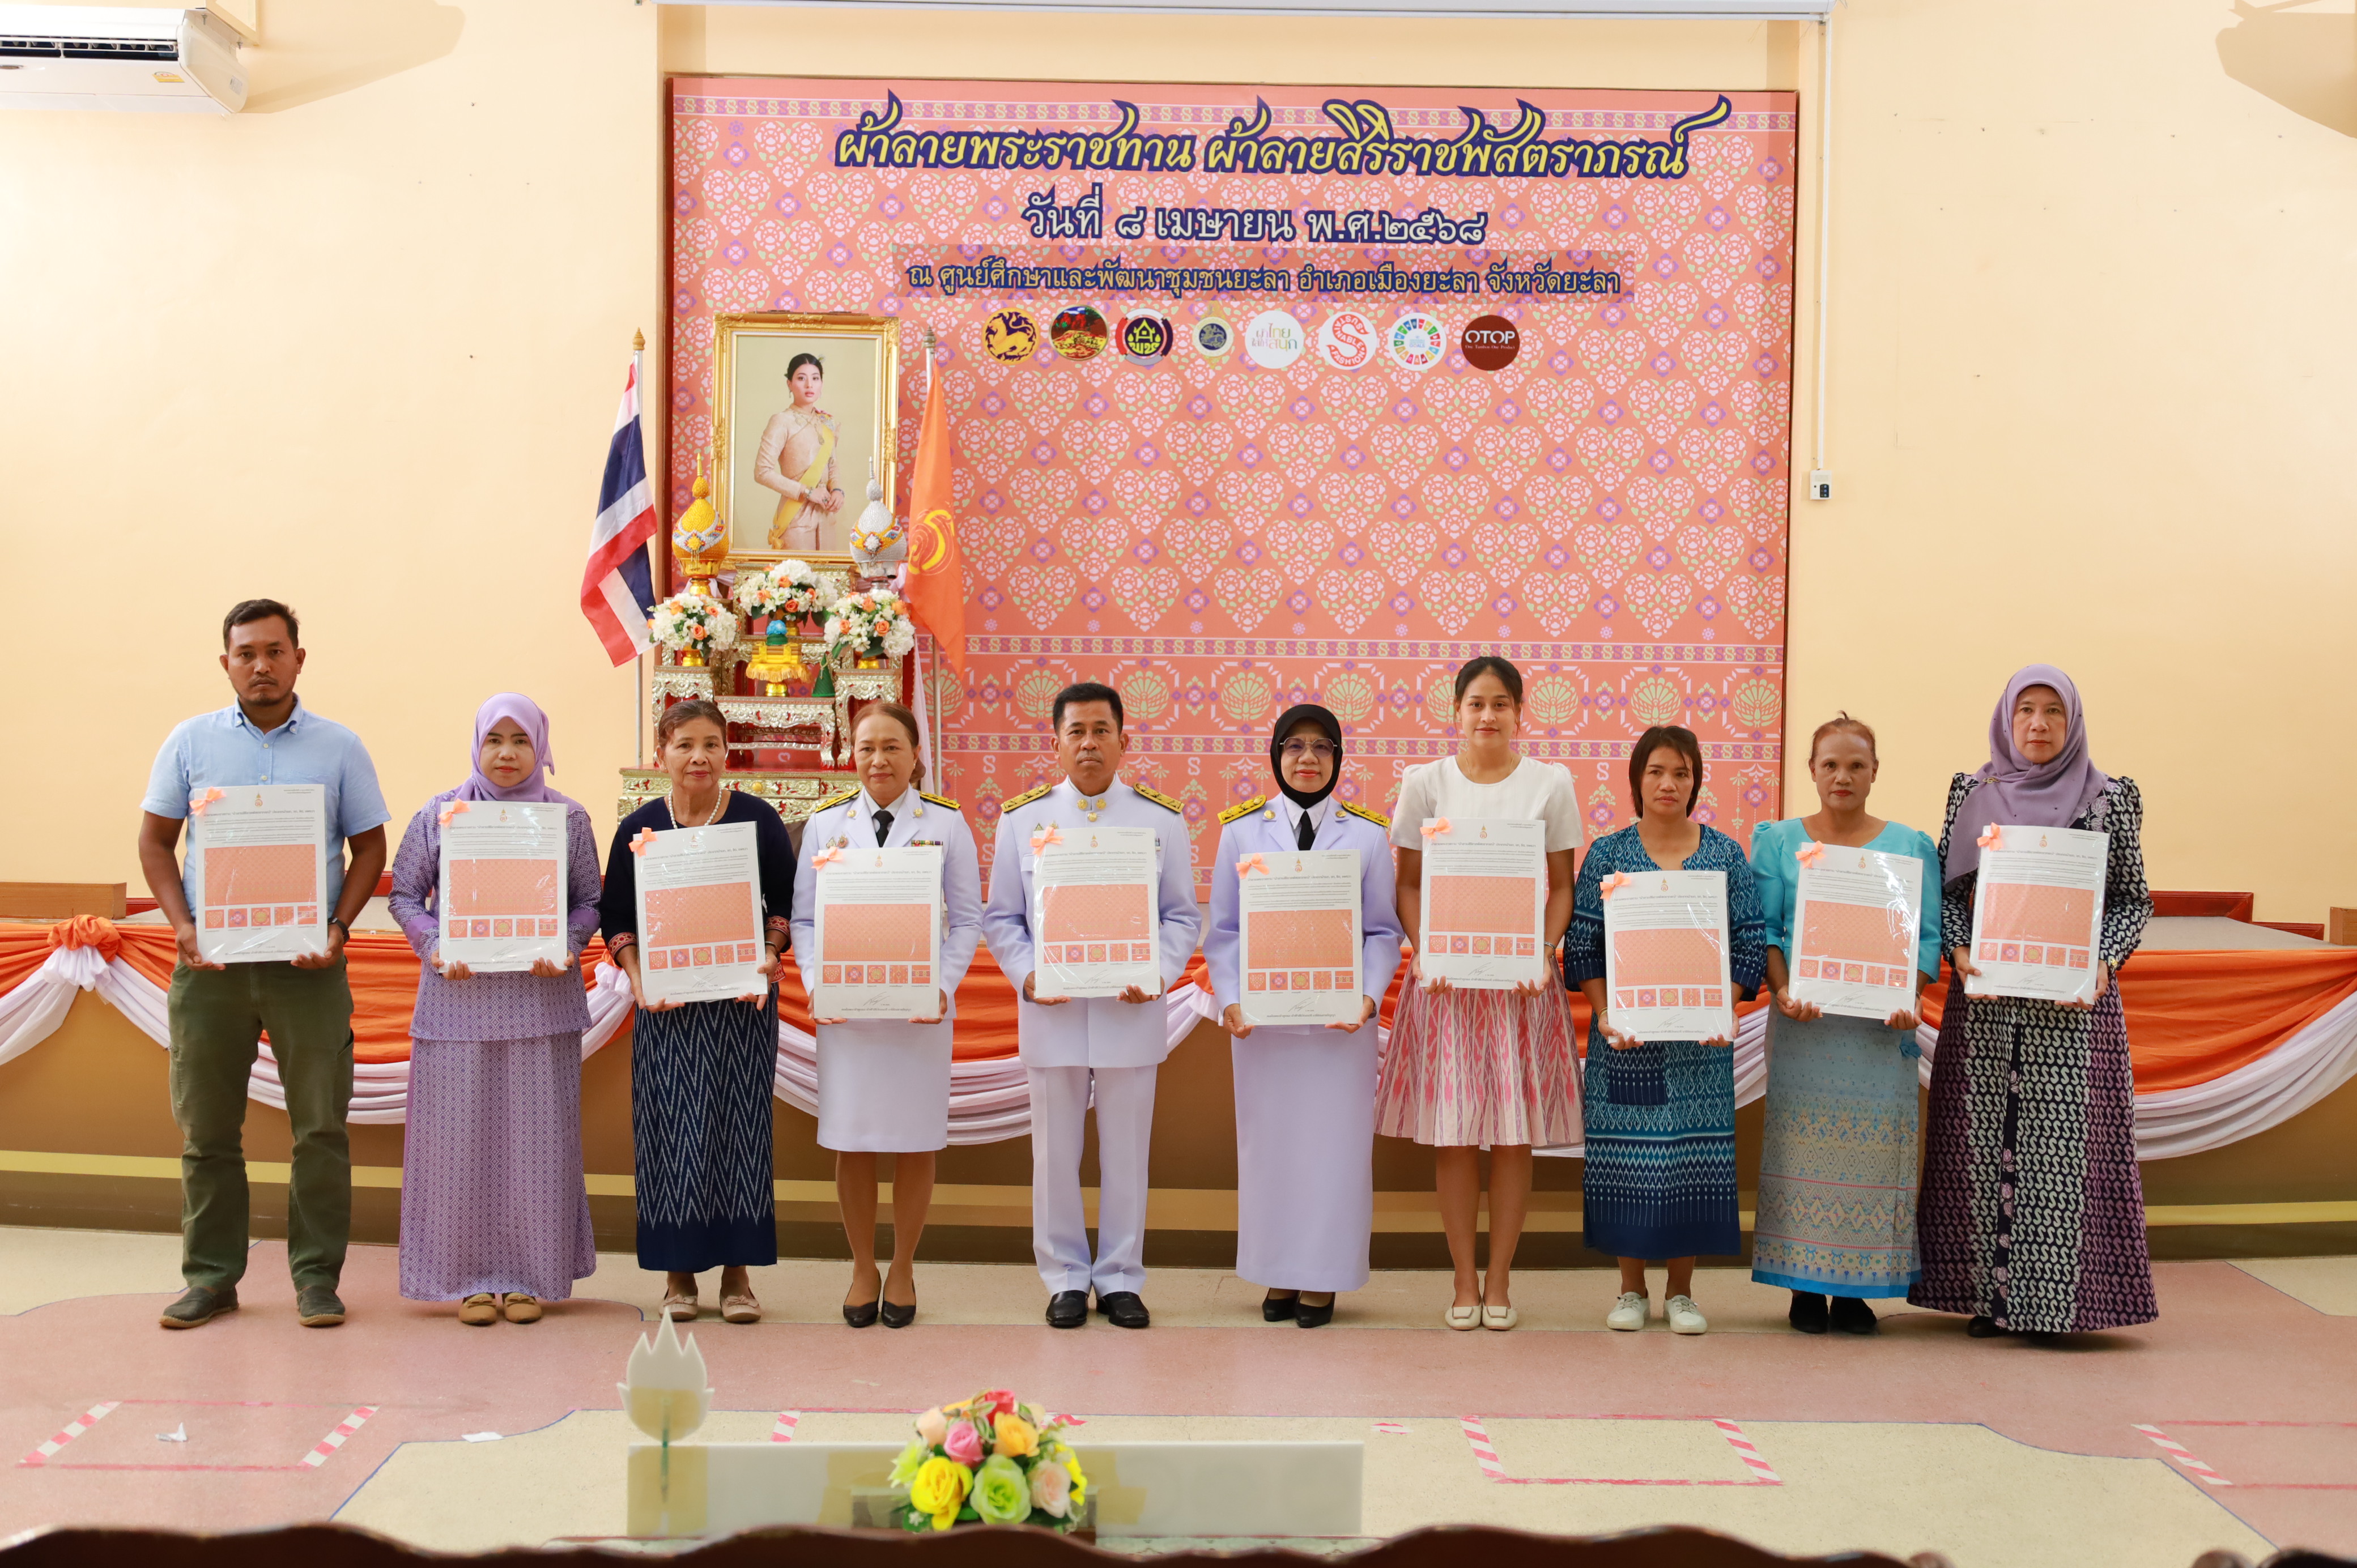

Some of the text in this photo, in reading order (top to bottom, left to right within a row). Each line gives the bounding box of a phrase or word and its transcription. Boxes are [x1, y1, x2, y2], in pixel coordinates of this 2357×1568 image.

[836, 92, 1730, 177] ผ้าลายพระราชทาน ผ้าลายสิริราชพัสตราภรณ์
[1023, 184, 1487, 244] วันที่ ๘ เมษายน พ.ศ.๒๕๖๘
[908, 255, 1620, 297] ณ ศูนย์ศึกษาและพัฒนาชุมชนยะลา อำเภอเมืองยะลา จังหวัดยะลา
[1331, 316, 1365, 365] SUSTAINABLE FASHION
[1465, 330, 1516, 344] OTOP
